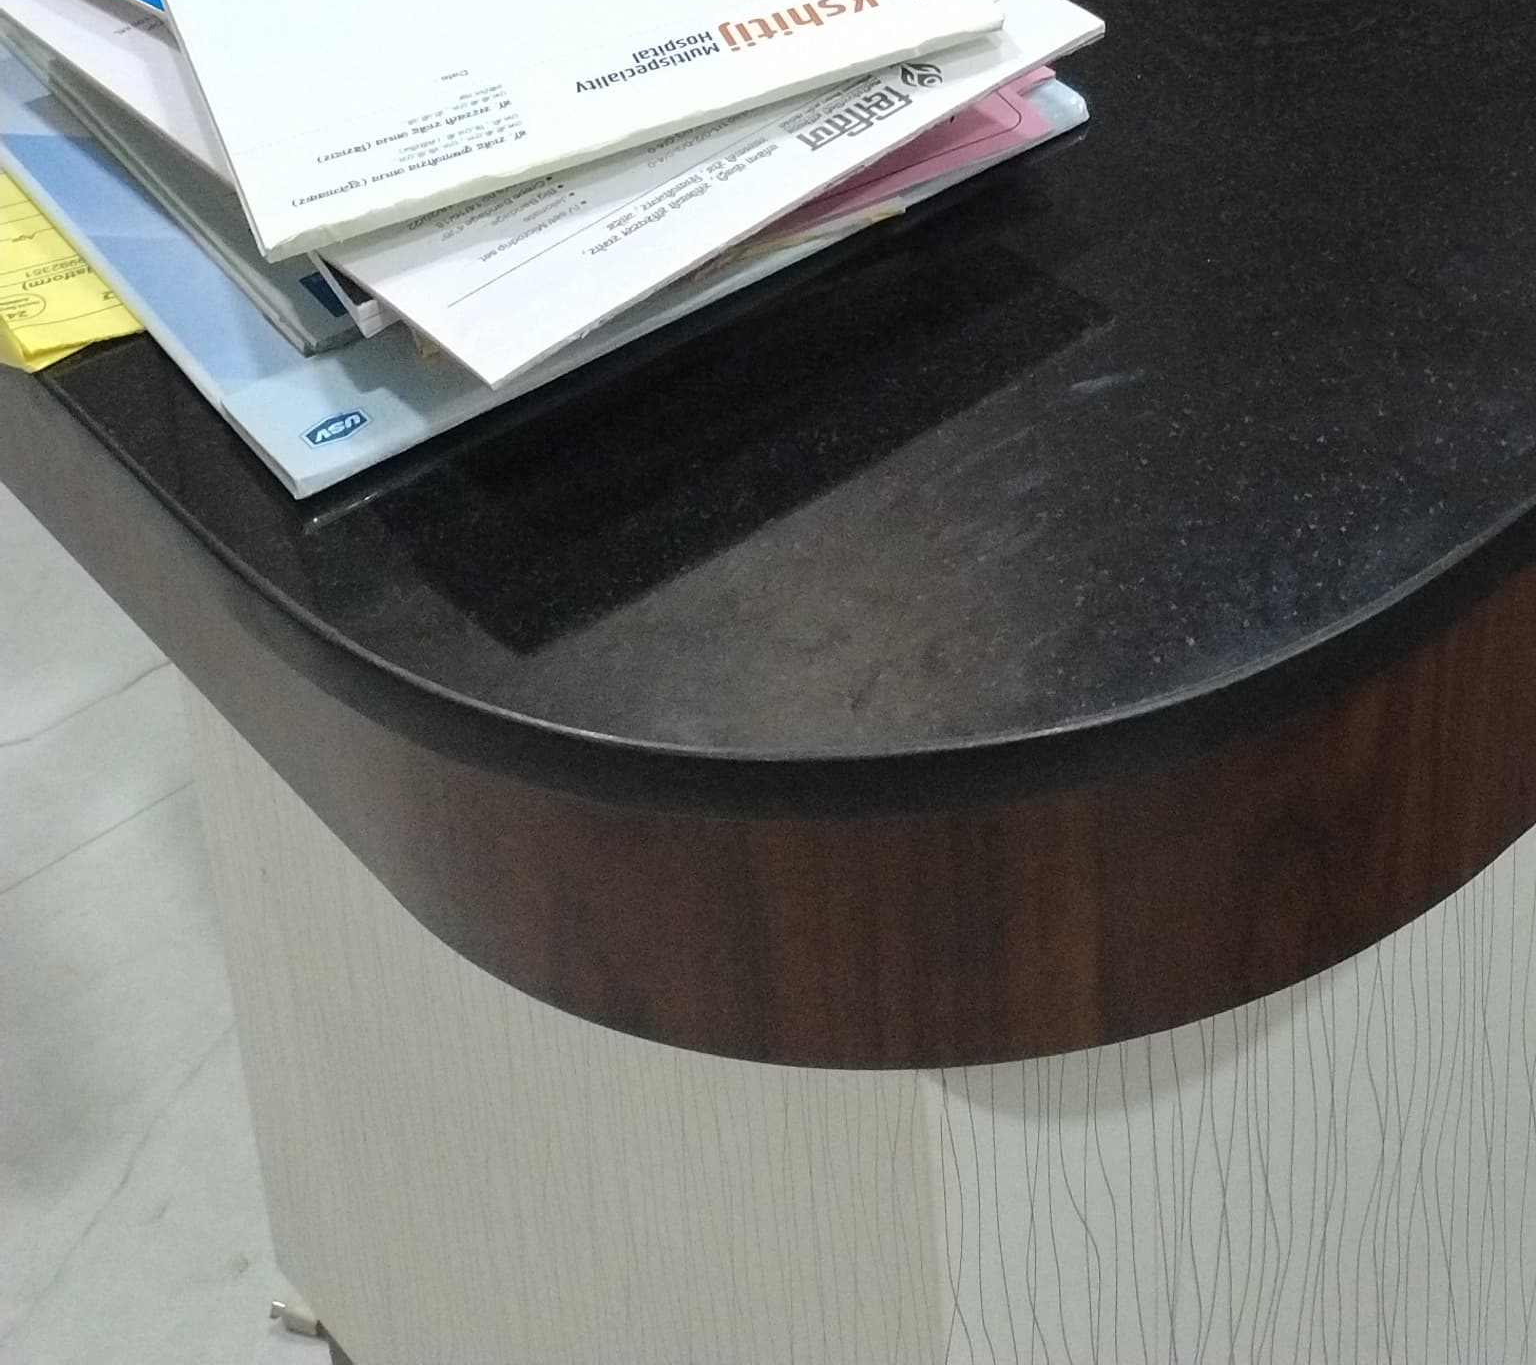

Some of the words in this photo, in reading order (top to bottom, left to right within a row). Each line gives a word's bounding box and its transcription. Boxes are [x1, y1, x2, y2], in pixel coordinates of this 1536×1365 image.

[631, 30, 714, 64] Hospital
[575, 44, 721, 94] Multispeciality
[795, 85, 913, 151] क्षितिज
[20, 265, 92, 291] latform)
[5, 308, 27, 320] 24
[312, 412, 362, 442] USV
